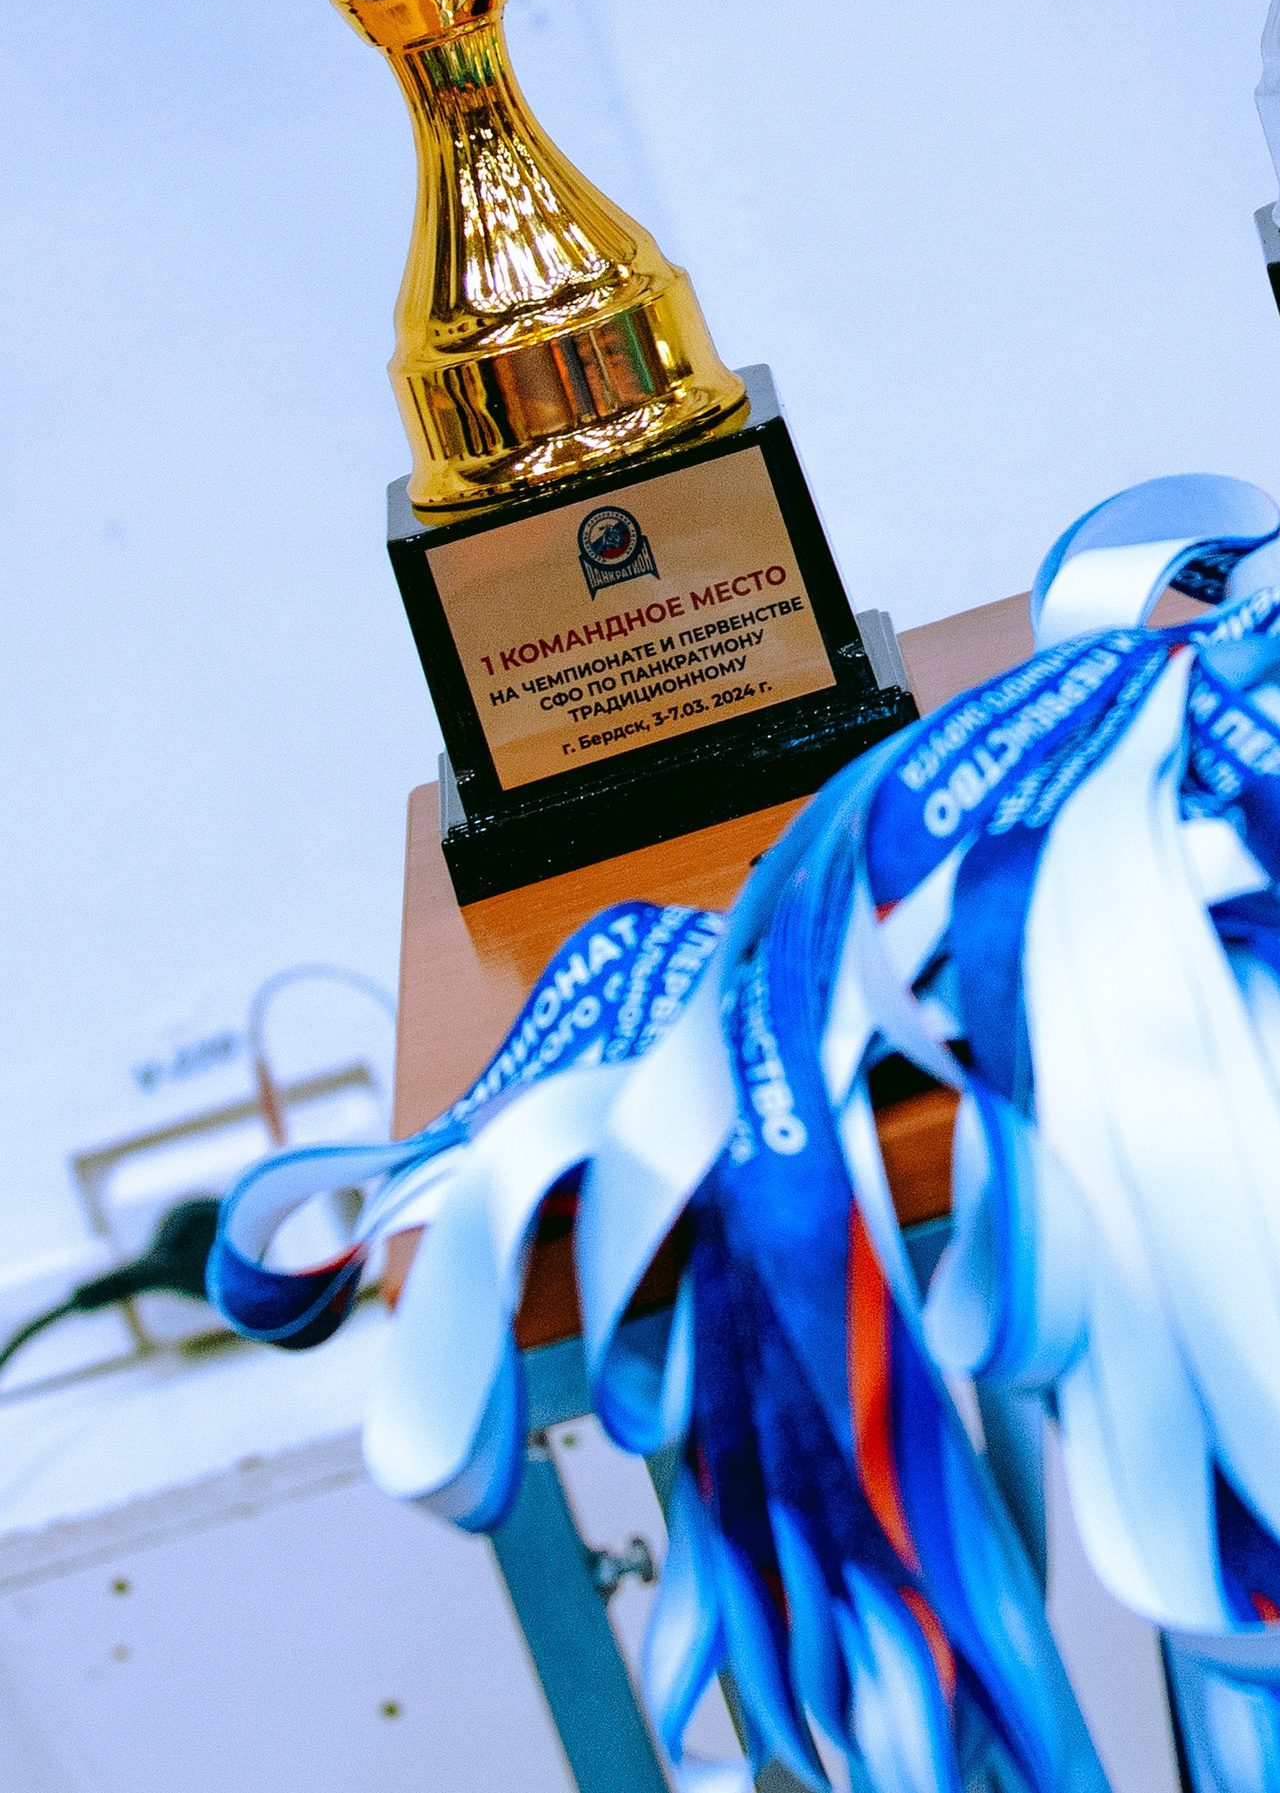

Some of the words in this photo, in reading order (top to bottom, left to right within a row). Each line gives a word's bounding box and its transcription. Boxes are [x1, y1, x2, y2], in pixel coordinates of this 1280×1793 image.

[481, 656, 494, 675] 1
[500, 597, 684, 670] КОМАНДНОЕ
[690, 566, 786, 610] МЕСТО
[490, 687, 519, 706] НА
[522, 642, 657, 693] ЧЕМПИОНАТЕ
[660, 637, 675, 652] И
[679, 596, 804, 646] ПЕРВЕНСТВЕ
[540, 688, 583, 710] СФО
[587, 677, 616, 696] ПО
[620, 629, 763, 686] ПАНКРАТИОНУ
[568, 655, 746, 722] ТРАДИЦИОННОМУ
[562, 743, 576, 755] г.
[578, 720, 650, 749] Бердск,
[711, 684, 755, 708] 2024
[759, 682, 772, 693] г.
